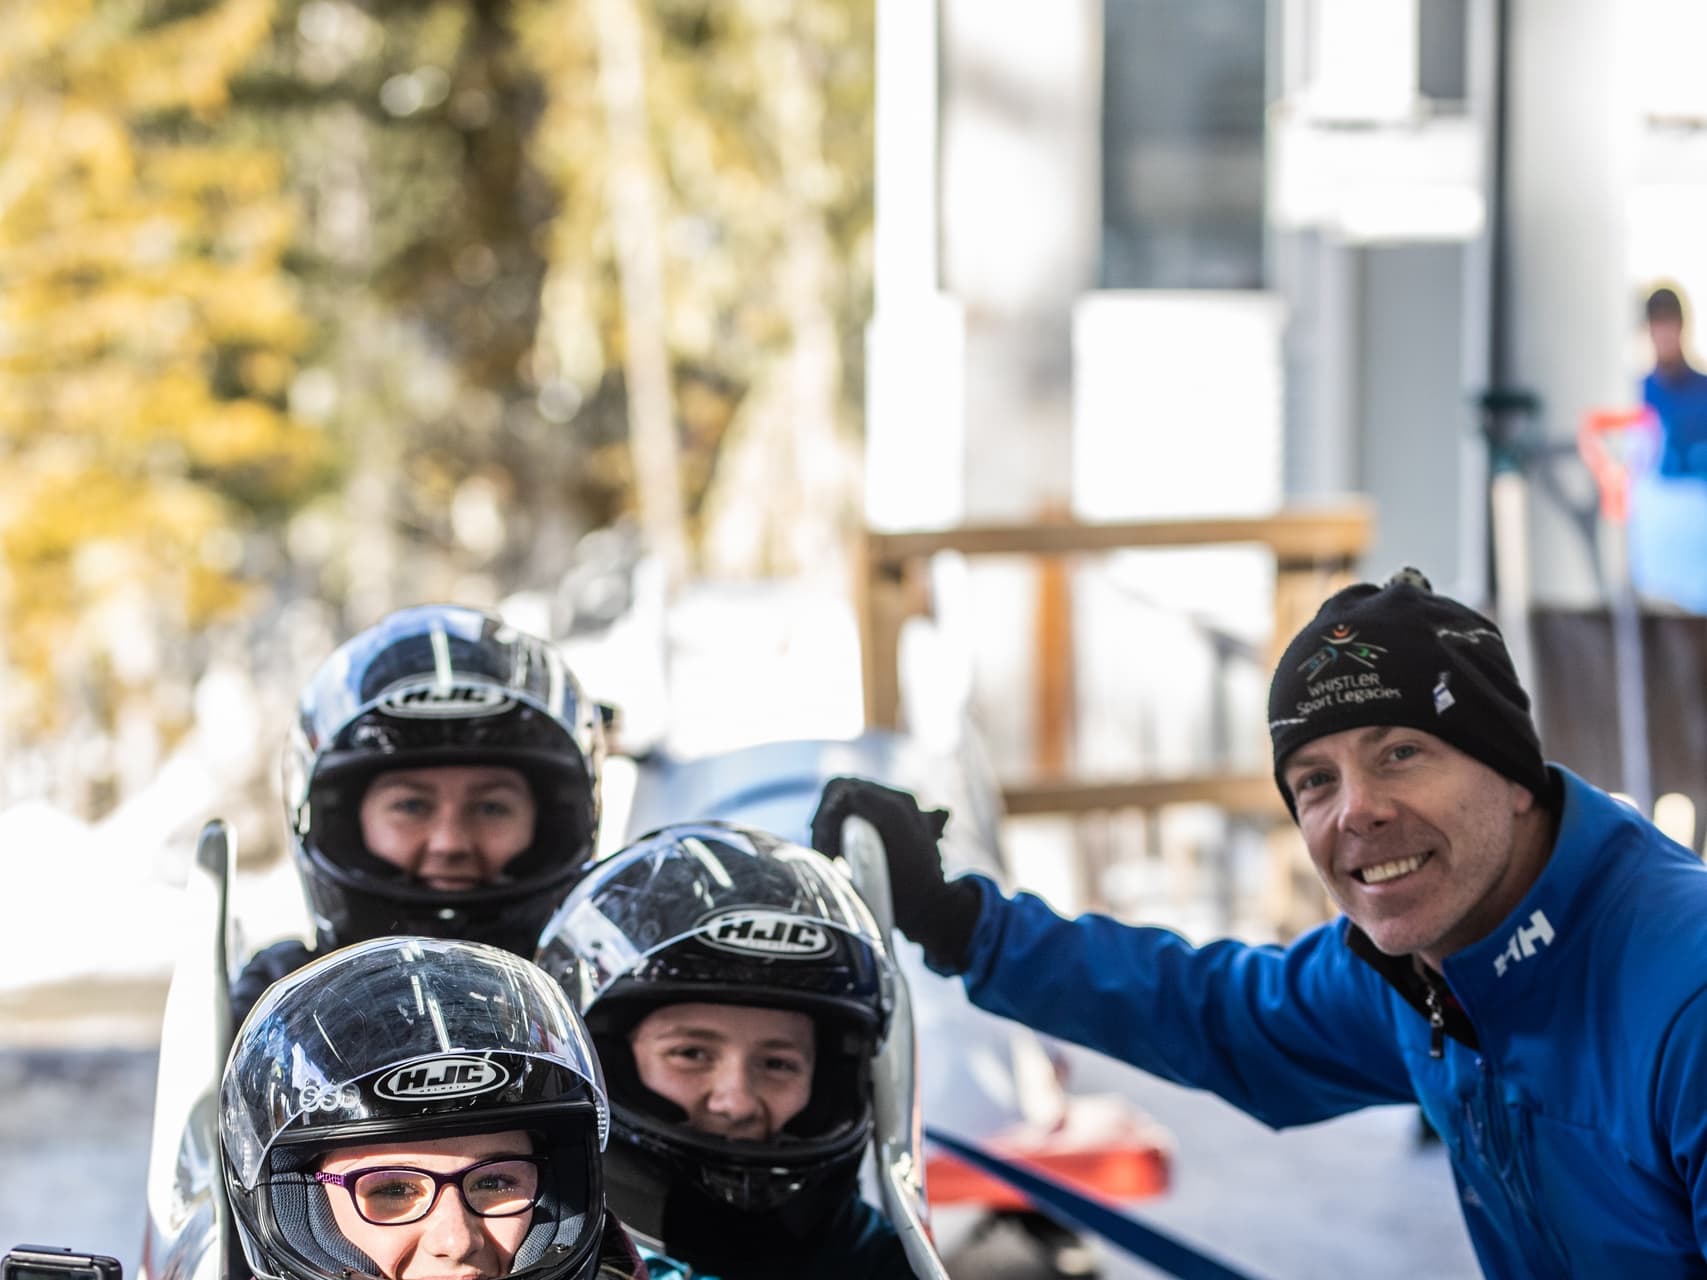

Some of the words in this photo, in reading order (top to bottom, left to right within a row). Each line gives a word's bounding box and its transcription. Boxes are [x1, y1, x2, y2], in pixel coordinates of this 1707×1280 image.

[1296, 695, 1333, 716] Sport
[1335, 687, 1402, 704] Legacies
[717, 918, 817, 947] HJC
[396, 1065, 485, 1092] HJC
